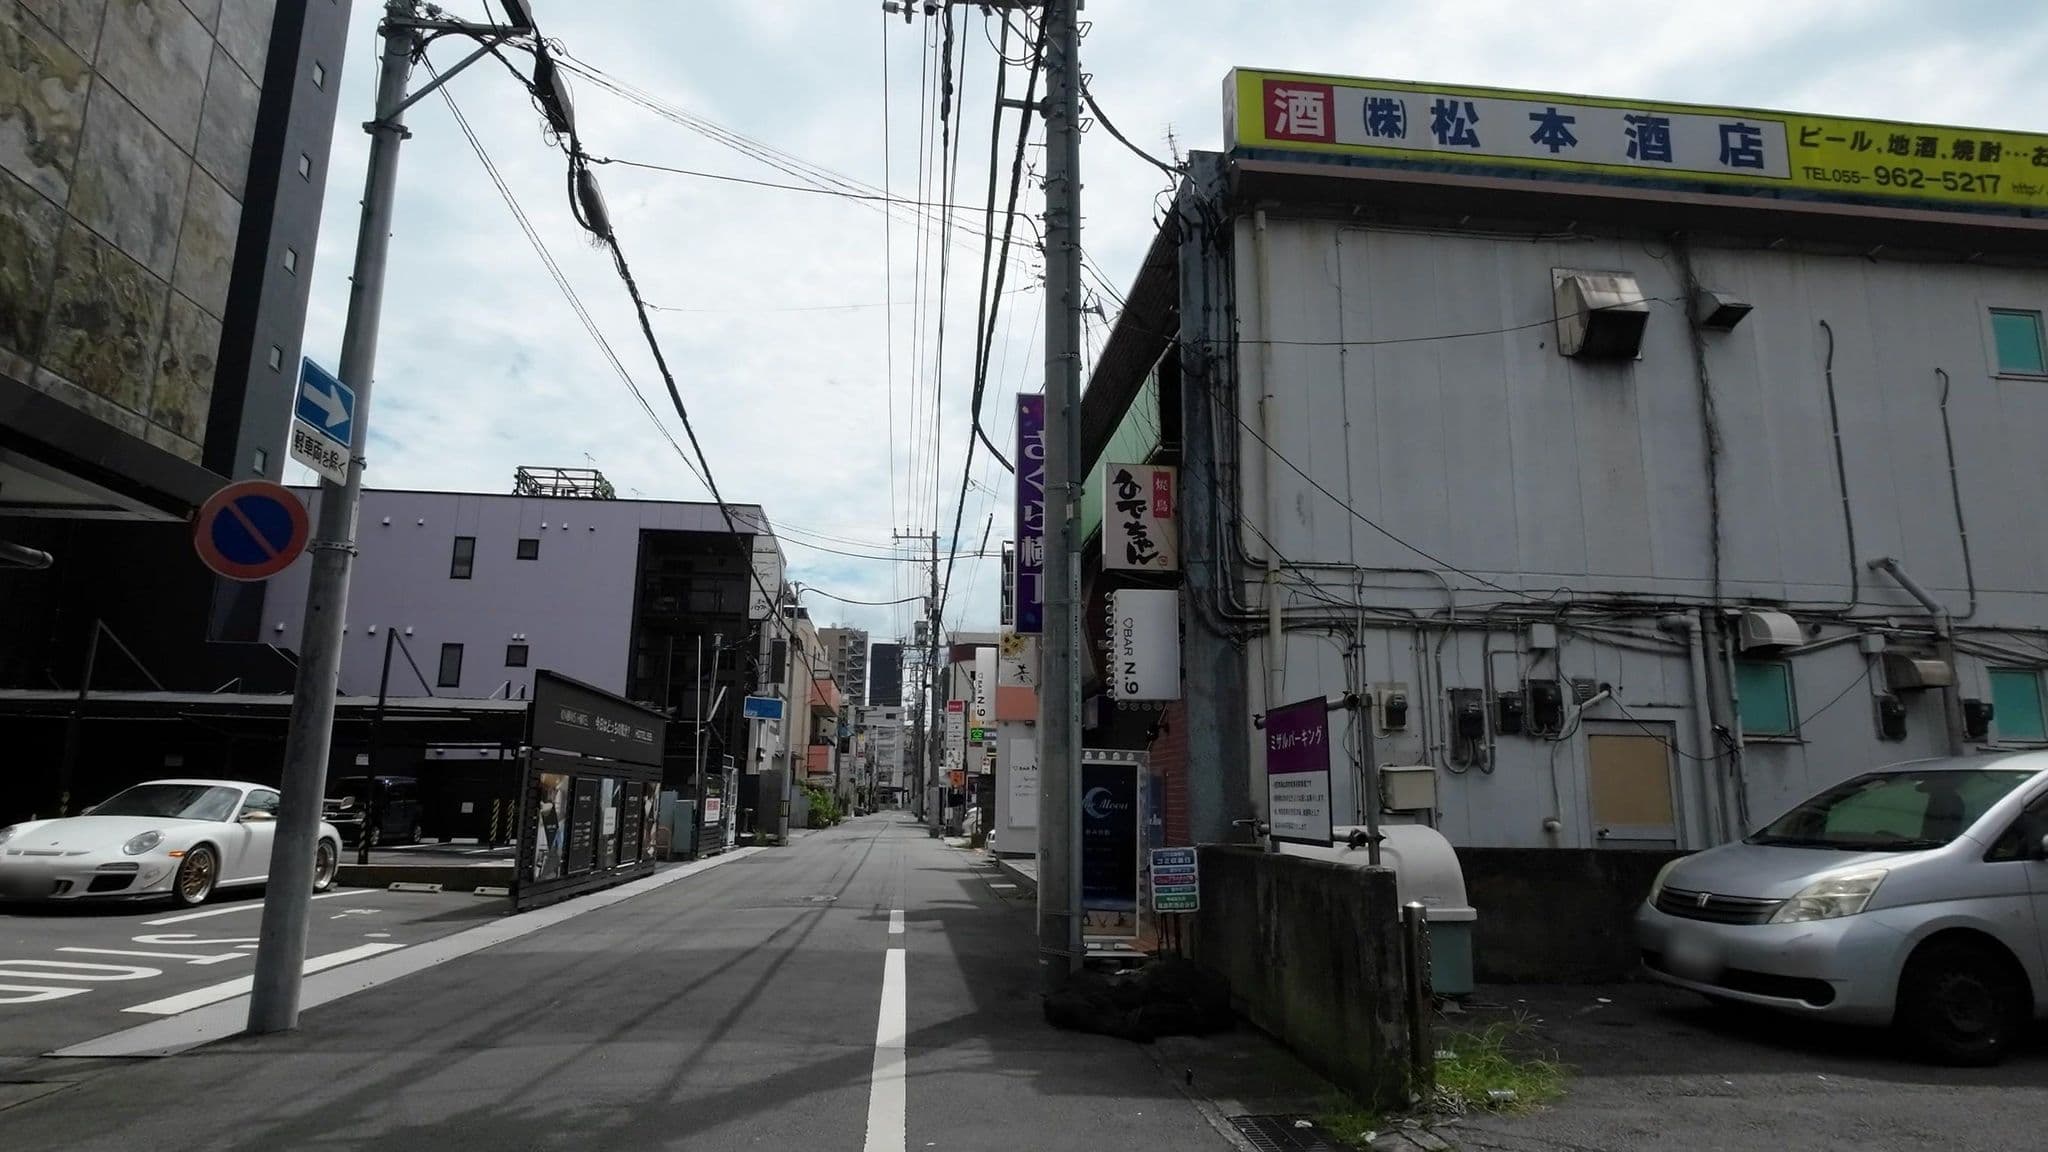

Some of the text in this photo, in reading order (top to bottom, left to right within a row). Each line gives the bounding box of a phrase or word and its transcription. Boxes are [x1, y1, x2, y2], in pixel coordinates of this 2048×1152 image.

[1274, 88, 1325, 137] 酒
[295, 430, 345, 478] 軽車両を除く
[1123, 629, 1139, 695] BAR N.9
